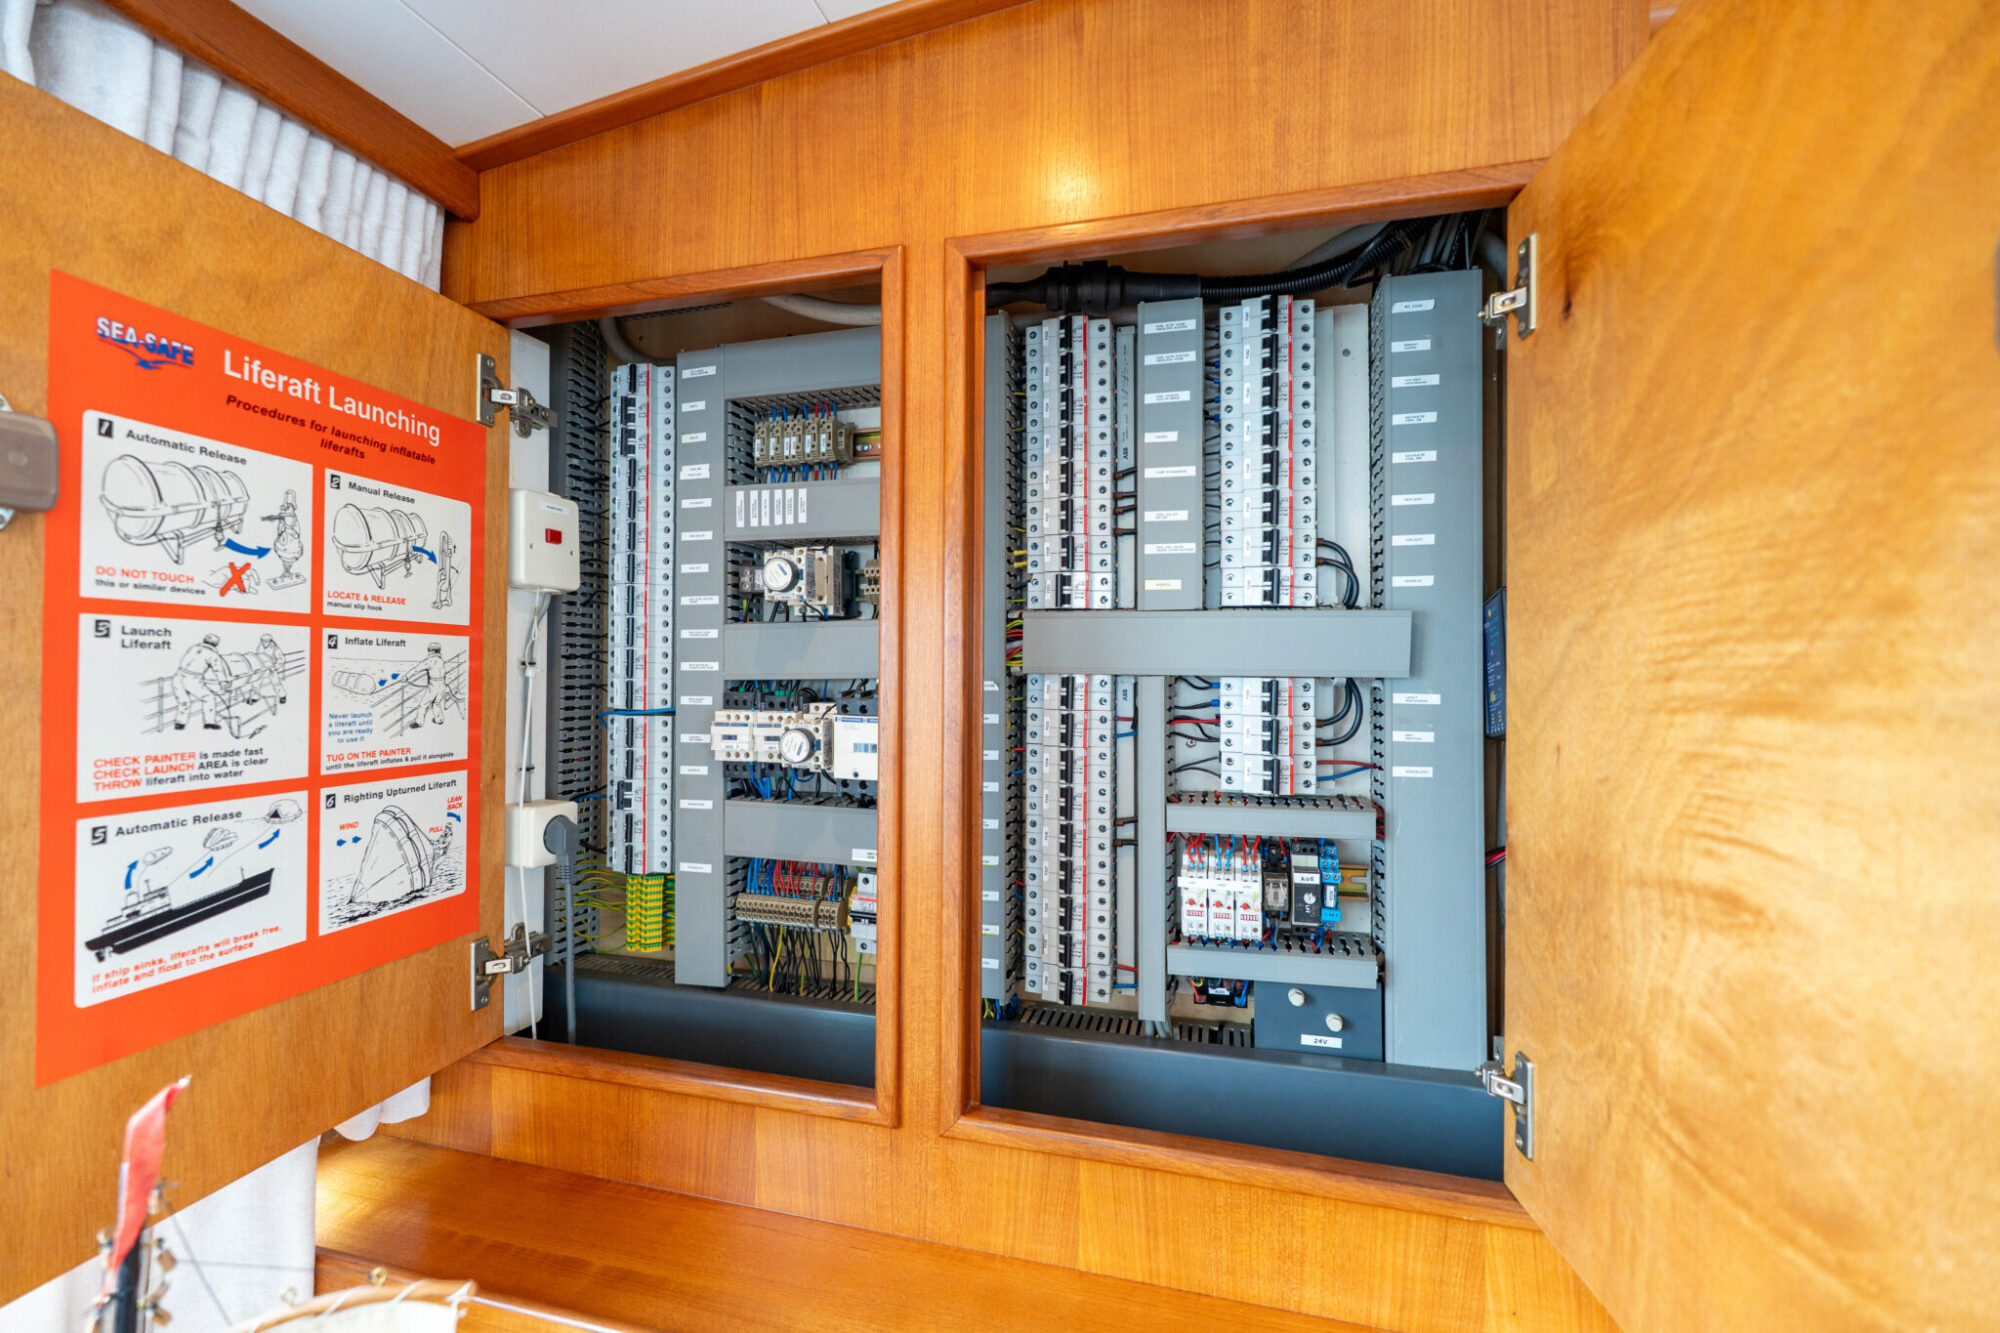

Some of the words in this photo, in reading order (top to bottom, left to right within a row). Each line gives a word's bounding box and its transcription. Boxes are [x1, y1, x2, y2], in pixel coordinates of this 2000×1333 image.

[95, 316, 194, 365] SEA-SAFE
[223, 349, 321, 404] Liferaft
[329, 386, 440, 447] Launching
[225, 394, 306, 427] Procedures
[310, 420, 327, 434] for
[331, 425, 387, 453] launching
[390, 444, 436, 465] inflatable
[126, 429, 195, 453] Automatic
[199, 446, 248, 465] Release
[320, 438, 365, 459] liferafts
[348, 481, 380, 497] Manual
[383, 487, 416, 504] Release
[95, 565, 116, 577] DO
[120, 568, 147, 581] NOT
[151, 571, 194, 584] TOUCH
[94, 578, 116, 588] this
[133, 582, 167, 592] similar
[169, 584, 206, 595] devices
[327, 590, 362, 602] LOCATE
[371, 594, 407, 606] RELEASE
[327, 600, 352, 609] manual
[354, 602, 366, 611] slip
[367, 603, 382, 612] hook
[120, 625, 172, 637] Launch
[120, 638, 171, 650] Liferaft
[345, 637, 374, 646] Inflate
[376, 638, 406, 647] Liferaft
[93, 755, 140, 769] CHECK
[144, 752, 196, 765] PAINTER
[199, 751, 209, 760] is
[212, 748, 241, 759] made
[244, 747, 264, 757] fast
[326, 753, 345, 762] TUG
[347, 752, 359, 760] ON
[361, 750, 377, 759] THE
[379, 747, 411, 758] PAINTER
[343, 761, 355, 769] the
[357, 758, 379, 767] liferaft
[93, 767, 140, 780] CHECK
[144, 763, 195, 776] LAUNCH
[197, 760, 228, 770] AREA
[231, 758, 240, 767] is
[243, 757, 269, 767] clear
[93, 778, 142, 792] THROW
[145, 773, 185, 786] liferaft
[189, 771, 211, 782] into
[214, 769, 244, 780] water
[344, 790, 383, 803] Righting
[386, 784, 426, 797] Upturned
[428, 779, 457, 791] Liferaft
[447, 795, 462, 804] LEAN
[447, 802, 463, 811] BACK
[114, 816, 188, 837] Automatic
[192, 809, 243, 825] Release
[339, 821, 360, 830] WIND
[104, 966, 130, 981] ship
[170, 945, 211, 962] liferafts
[213, 937, 230, 949] will
[233, 931, 259, 945] break
[133, 969, 154, 982] and
[185, 958, 196, 968] to
[199, 952, 215, 963] the
[218, 941, 254, 958] surface
